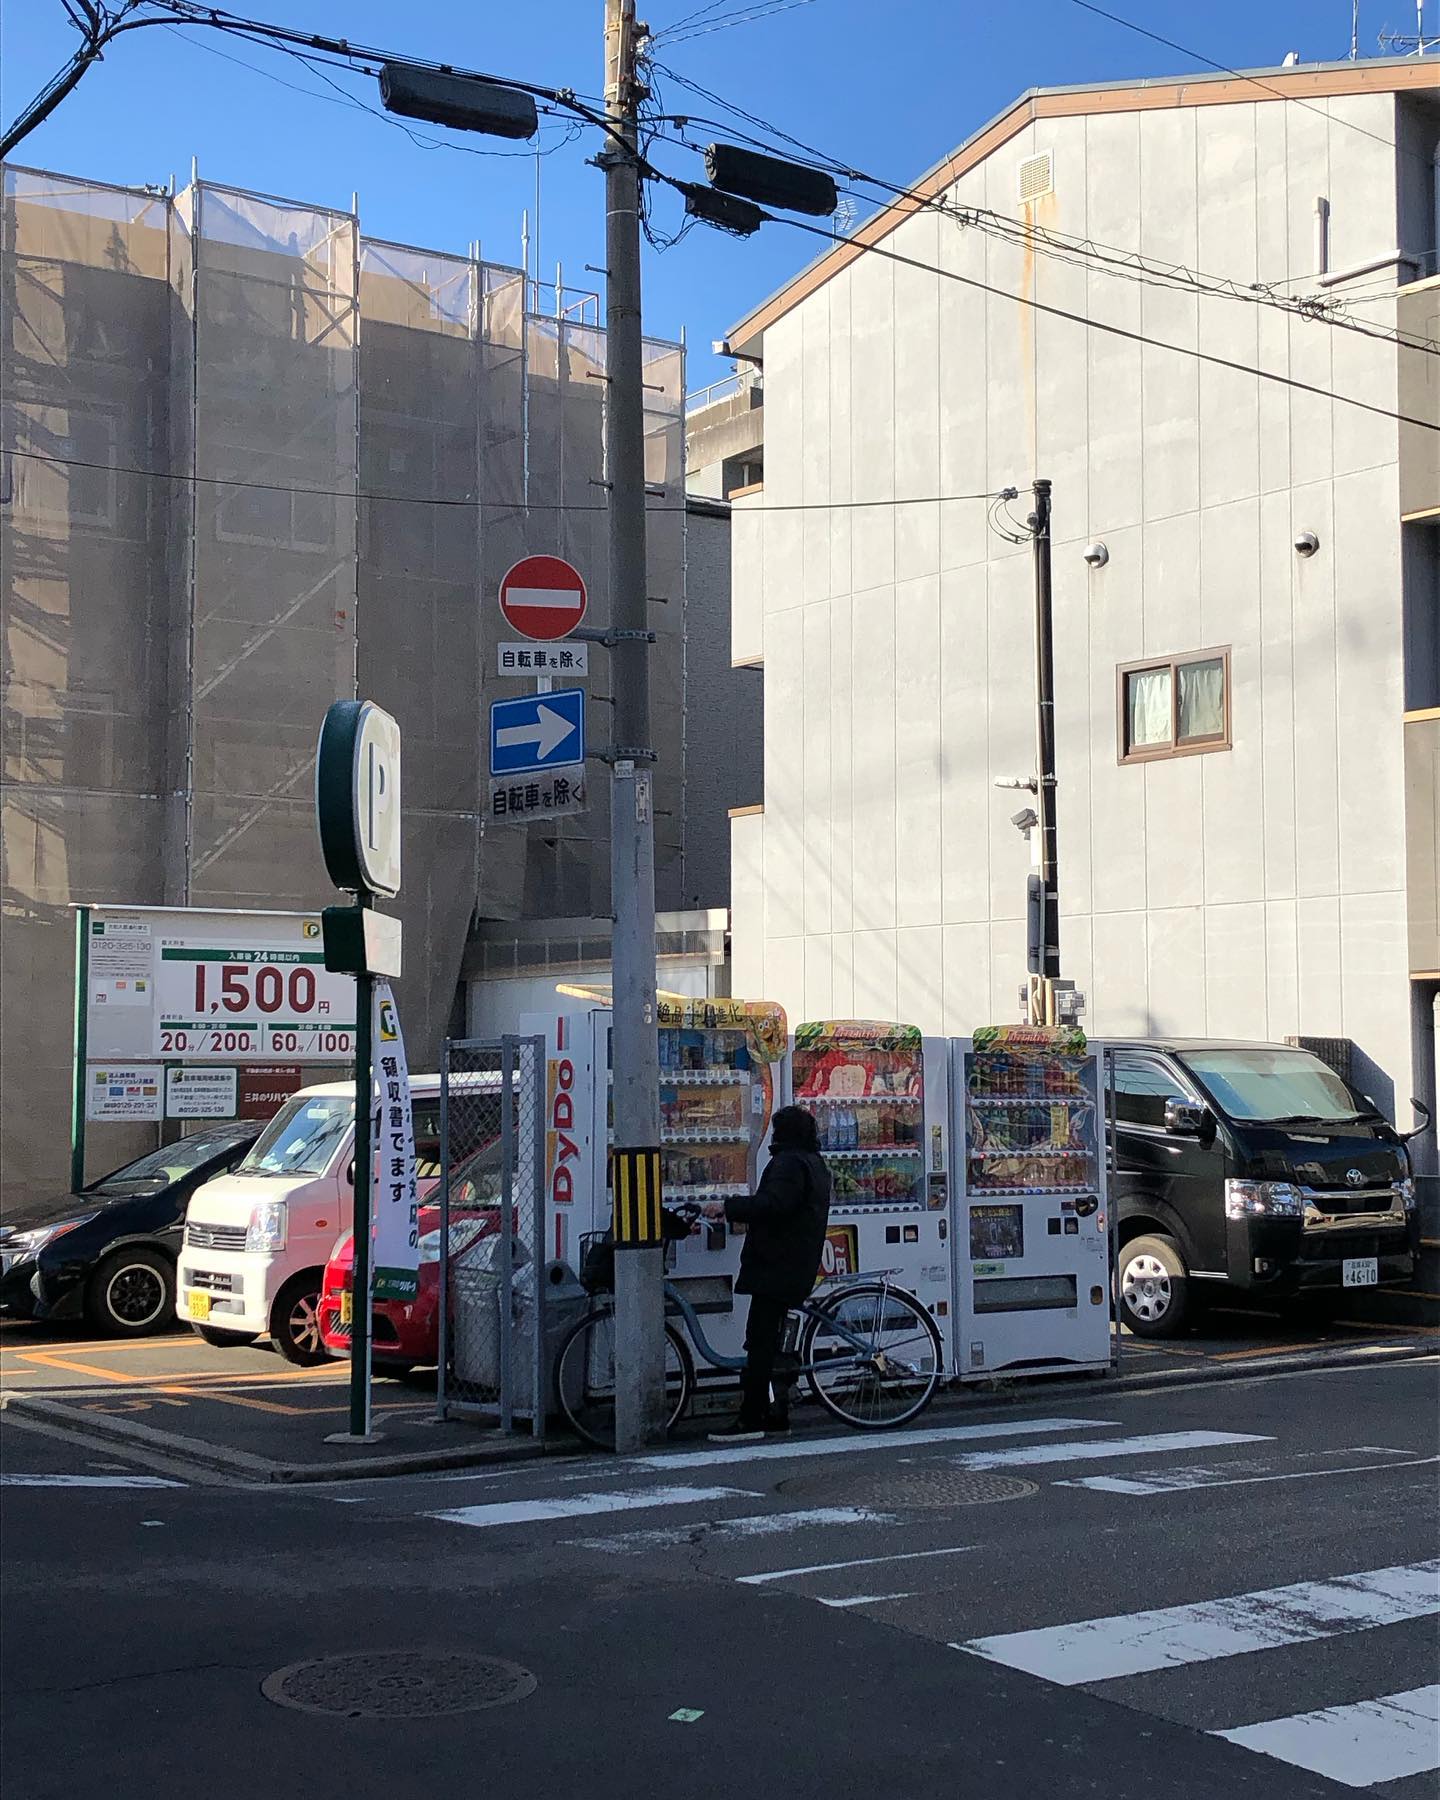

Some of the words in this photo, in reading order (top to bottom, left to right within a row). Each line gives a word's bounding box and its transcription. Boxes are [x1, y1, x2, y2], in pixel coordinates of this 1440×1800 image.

[502, 651, 584, 669] 自転車を除く
[493, 778, 581, 815] 自転車を除く
[195, 964, 330, 1015] 1,500円
[380, 1056, 405, 1203] 領収書でます
[1351, 1268, 1376, 1284] 46-10
